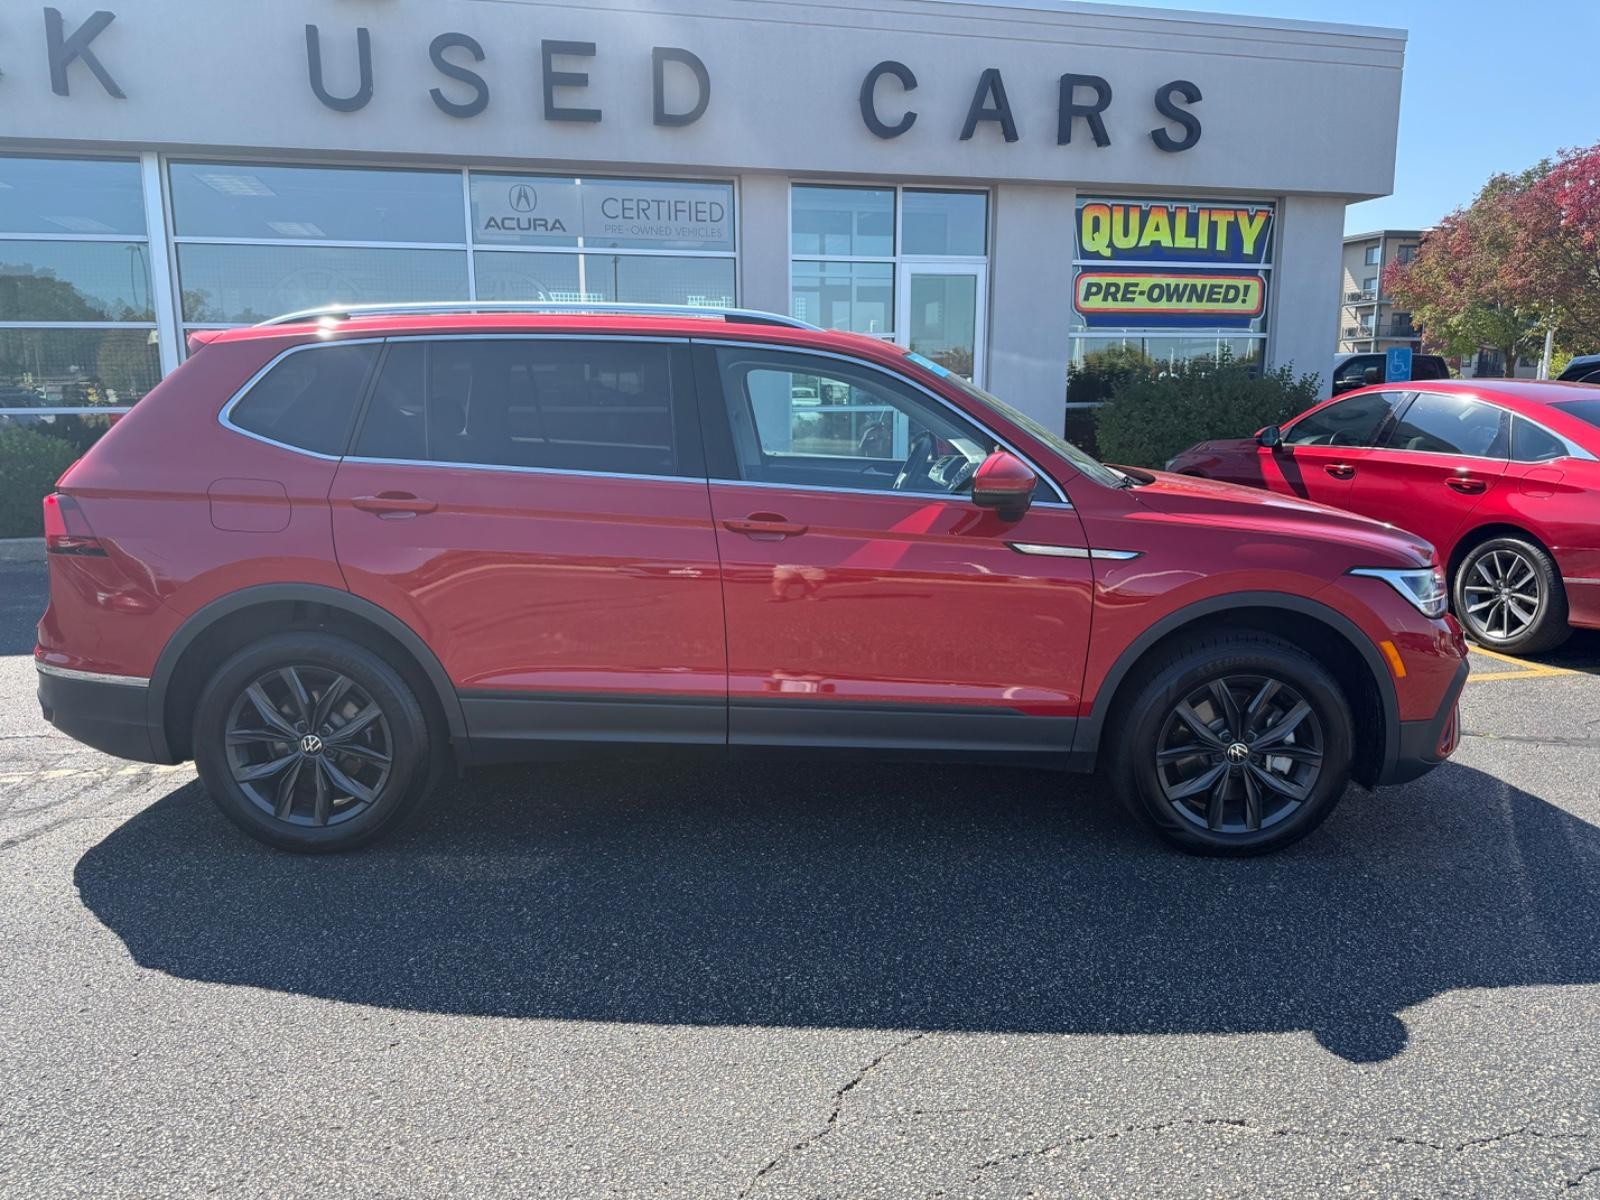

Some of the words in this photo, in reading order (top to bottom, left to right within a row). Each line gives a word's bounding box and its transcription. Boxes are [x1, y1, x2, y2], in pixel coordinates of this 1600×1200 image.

[0, 7, 127, 99] K
[305, 24, 711, 127] USED
[859, 60, 1203, 152] CARS
[601, 197, 725, 223] CERTIFIED
[484, 215, 567, 233] ACURA
[676, 226, 723, 239] VEHICLES
[1081, 203, 1270, 257] QUALITY
[1083, 281, 1252, 305] PRE-OWNED!
